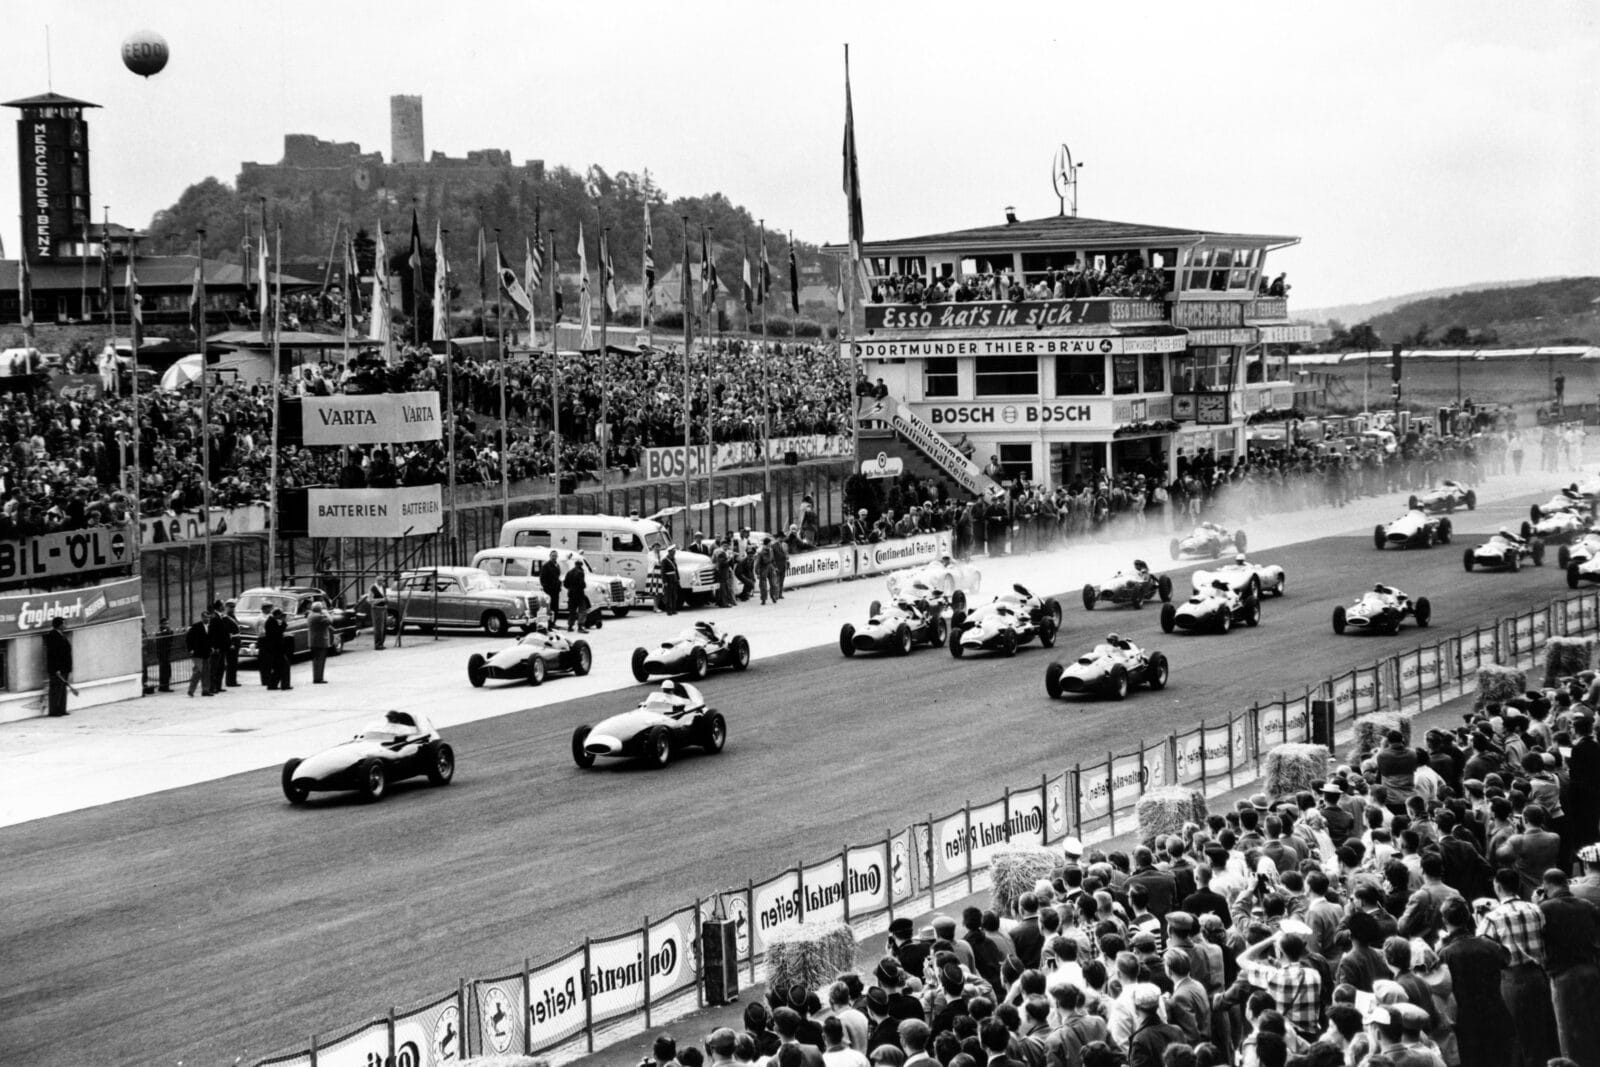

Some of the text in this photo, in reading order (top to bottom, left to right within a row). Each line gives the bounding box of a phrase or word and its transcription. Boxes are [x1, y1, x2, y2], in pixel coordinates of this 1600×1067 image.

[34, 123, 51, 257] MERCEDES-BENZ
[882, 307, 933, 327] Esso
[940, 305, 992, 326] hat's
[996, 304, 1019, 325] in
[865, 342, 978, 357] DORTMUNDER
[318, 405, 435, 426] VARTA VARTA
[931, 407, 994, 424] BOSCH
[1026, 405, 1092, 423] BOSCH
[892, 414, 977, 490] Continental Reifen
[909, 413, 968, 469] Willkommen
[649, 448, 707, 478] BOSCH
[318, 501, 439, 518] BATTERIEN BATTERIEN
[874, 541, 936, 565] Continental Reifen
[816, 558, 839, 572] Reifen
